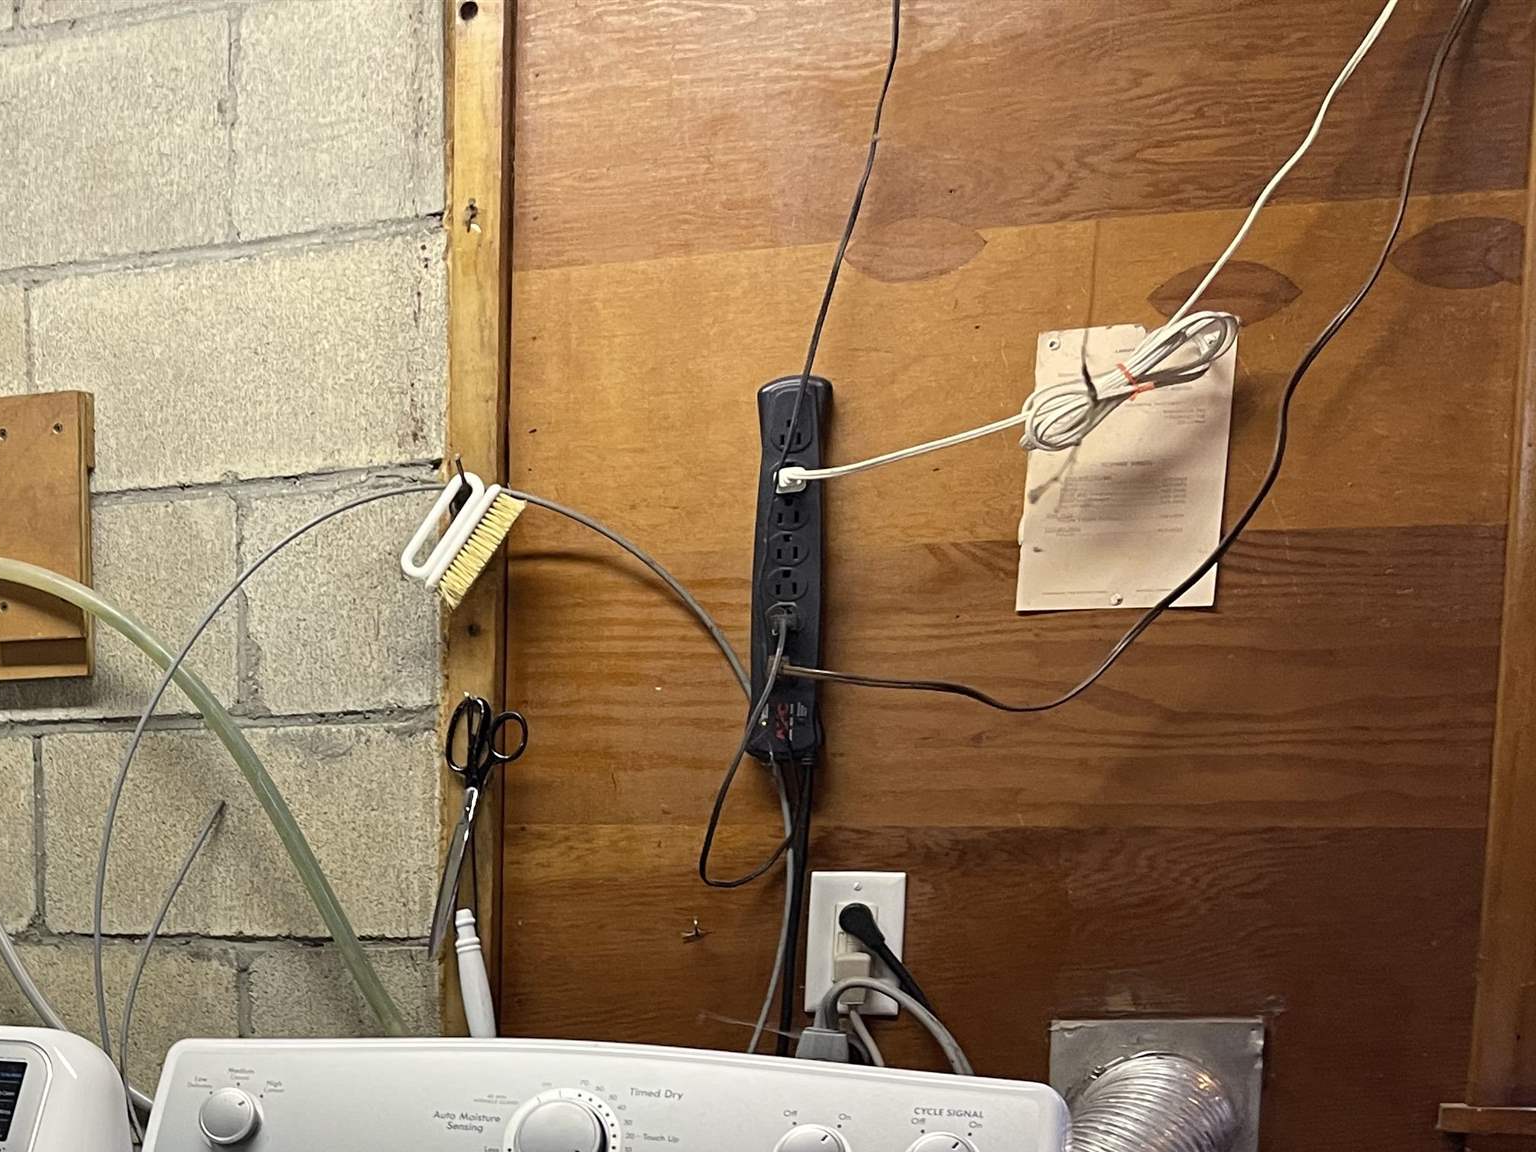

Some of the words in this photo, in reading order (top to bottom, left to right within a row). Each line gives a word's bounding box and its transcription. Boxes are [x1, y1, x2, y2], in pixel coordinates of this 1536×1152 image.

[630, 1087, 662, 1098] Timed
[664, 1089, 684, 1100] Dry
[433, 1111, 457, 1120] Auto
[459, 1112, 501, 1123] Moisture
[838, 1113, 852, 1121] On
[914, 1107, 945, 1116] CYCLE
[946, 1109, 984, 1119] SIGNAL
[911, 1118, 926, 1126] Off
[969, 1121, 983, 1129] On
[447, 1121, 484, 1134] Sensing
[484, 1145, 500, 1152] Less
